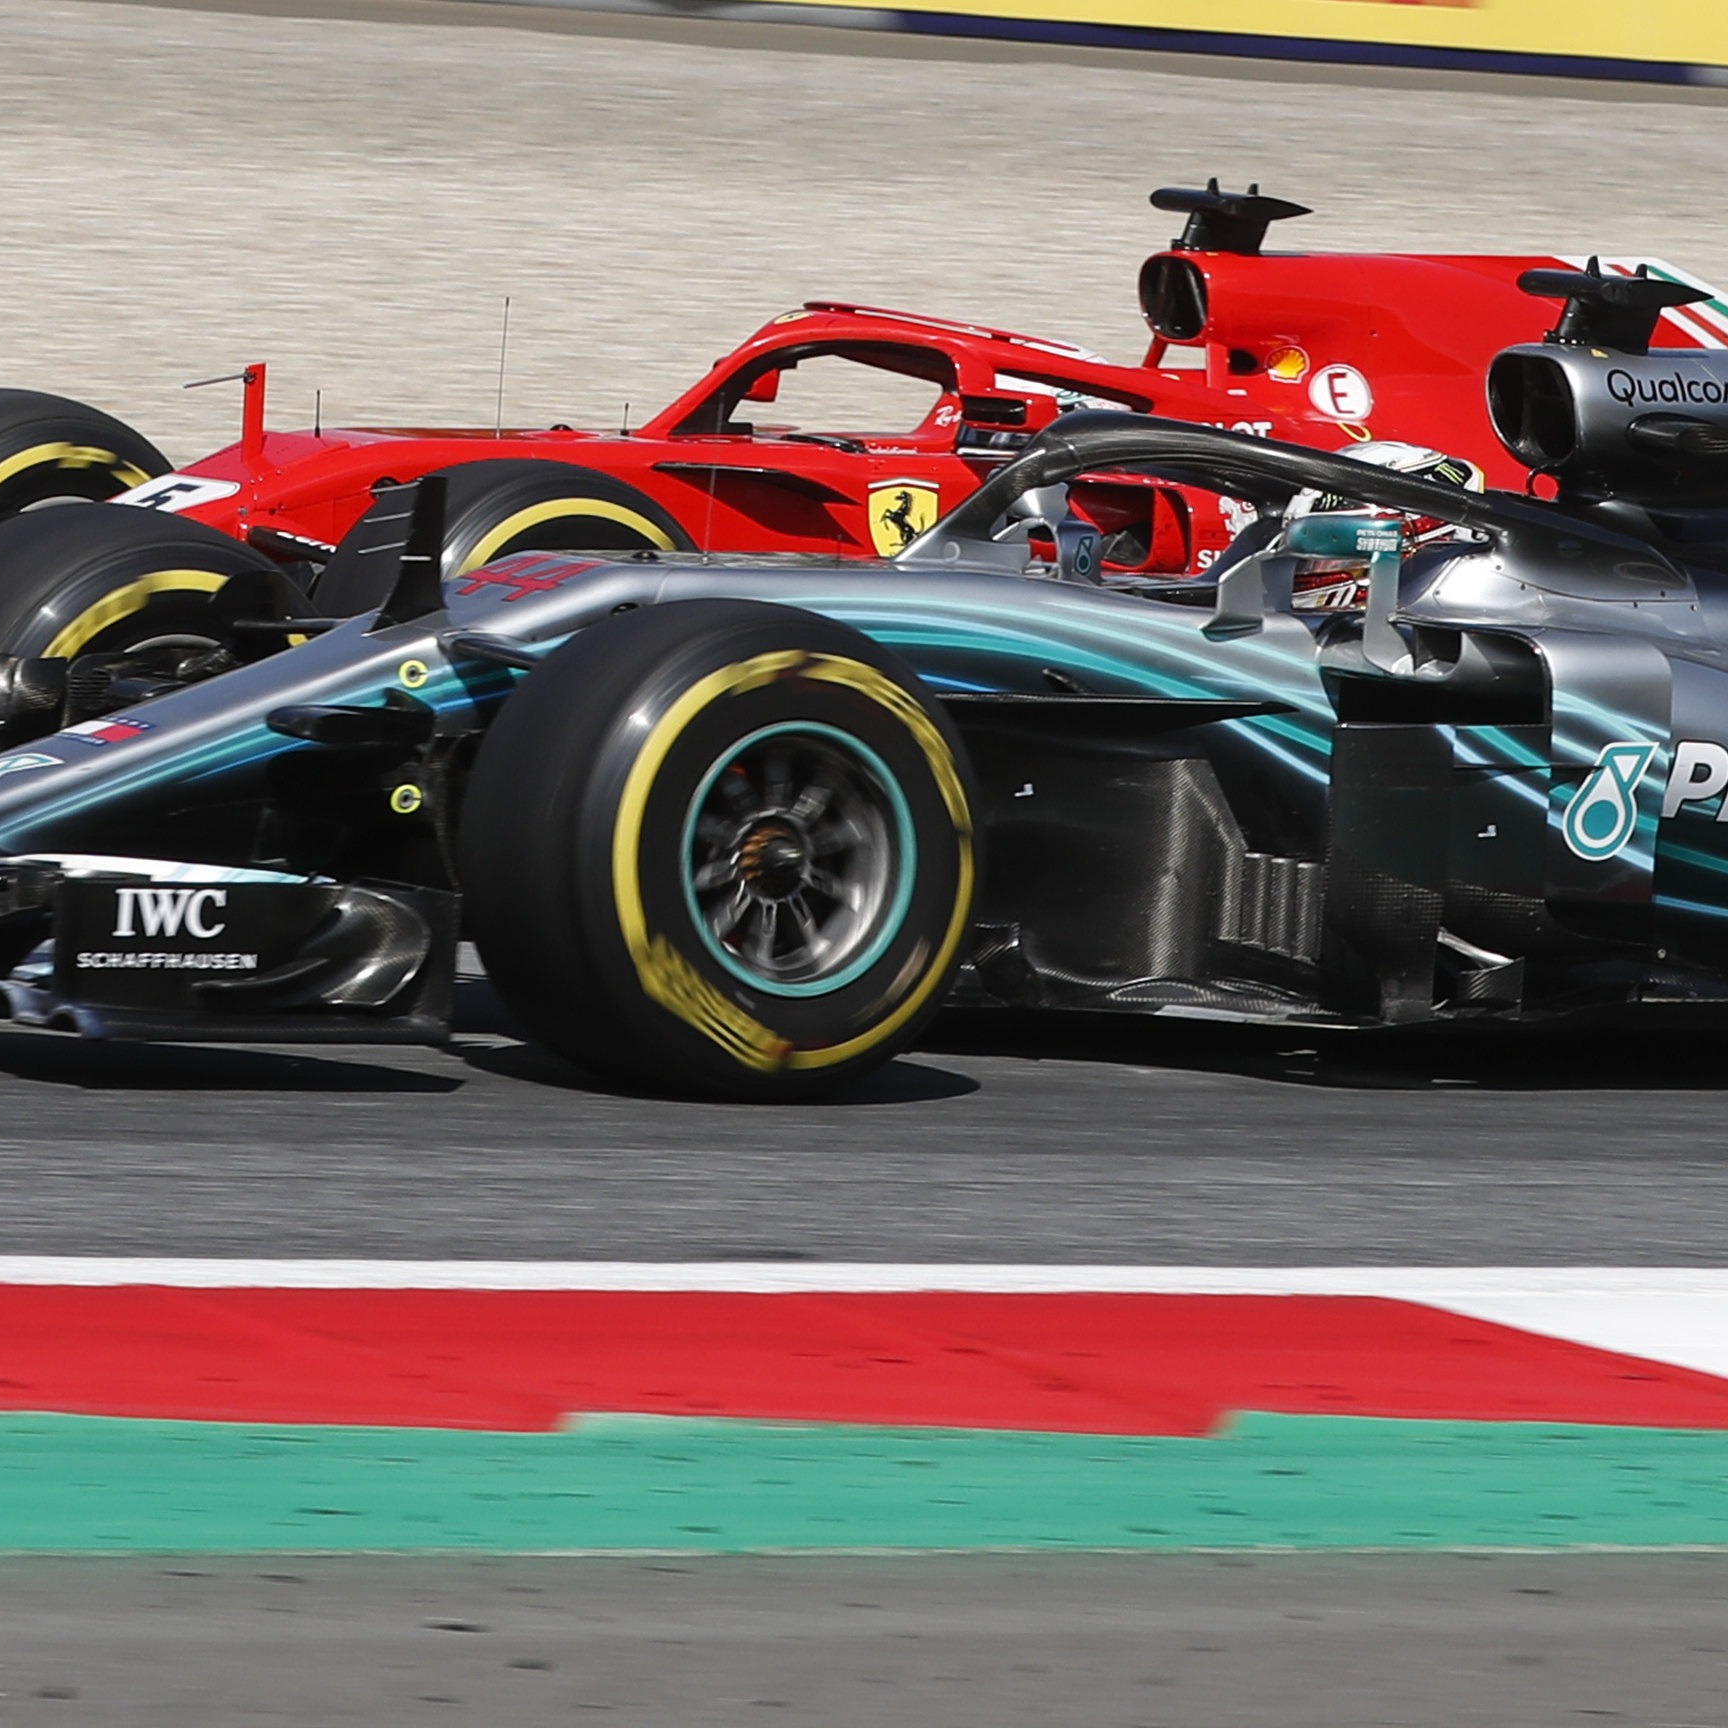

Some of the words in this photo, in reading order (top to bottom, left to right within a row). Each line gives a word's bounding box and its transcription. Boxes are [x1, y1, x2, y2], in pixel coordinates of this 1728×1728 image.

[455, 553, 611, 602] 44
[112, 889, 227, 939] IWC
[76, 952, 258, 970] SCHAFFHAUSEN
